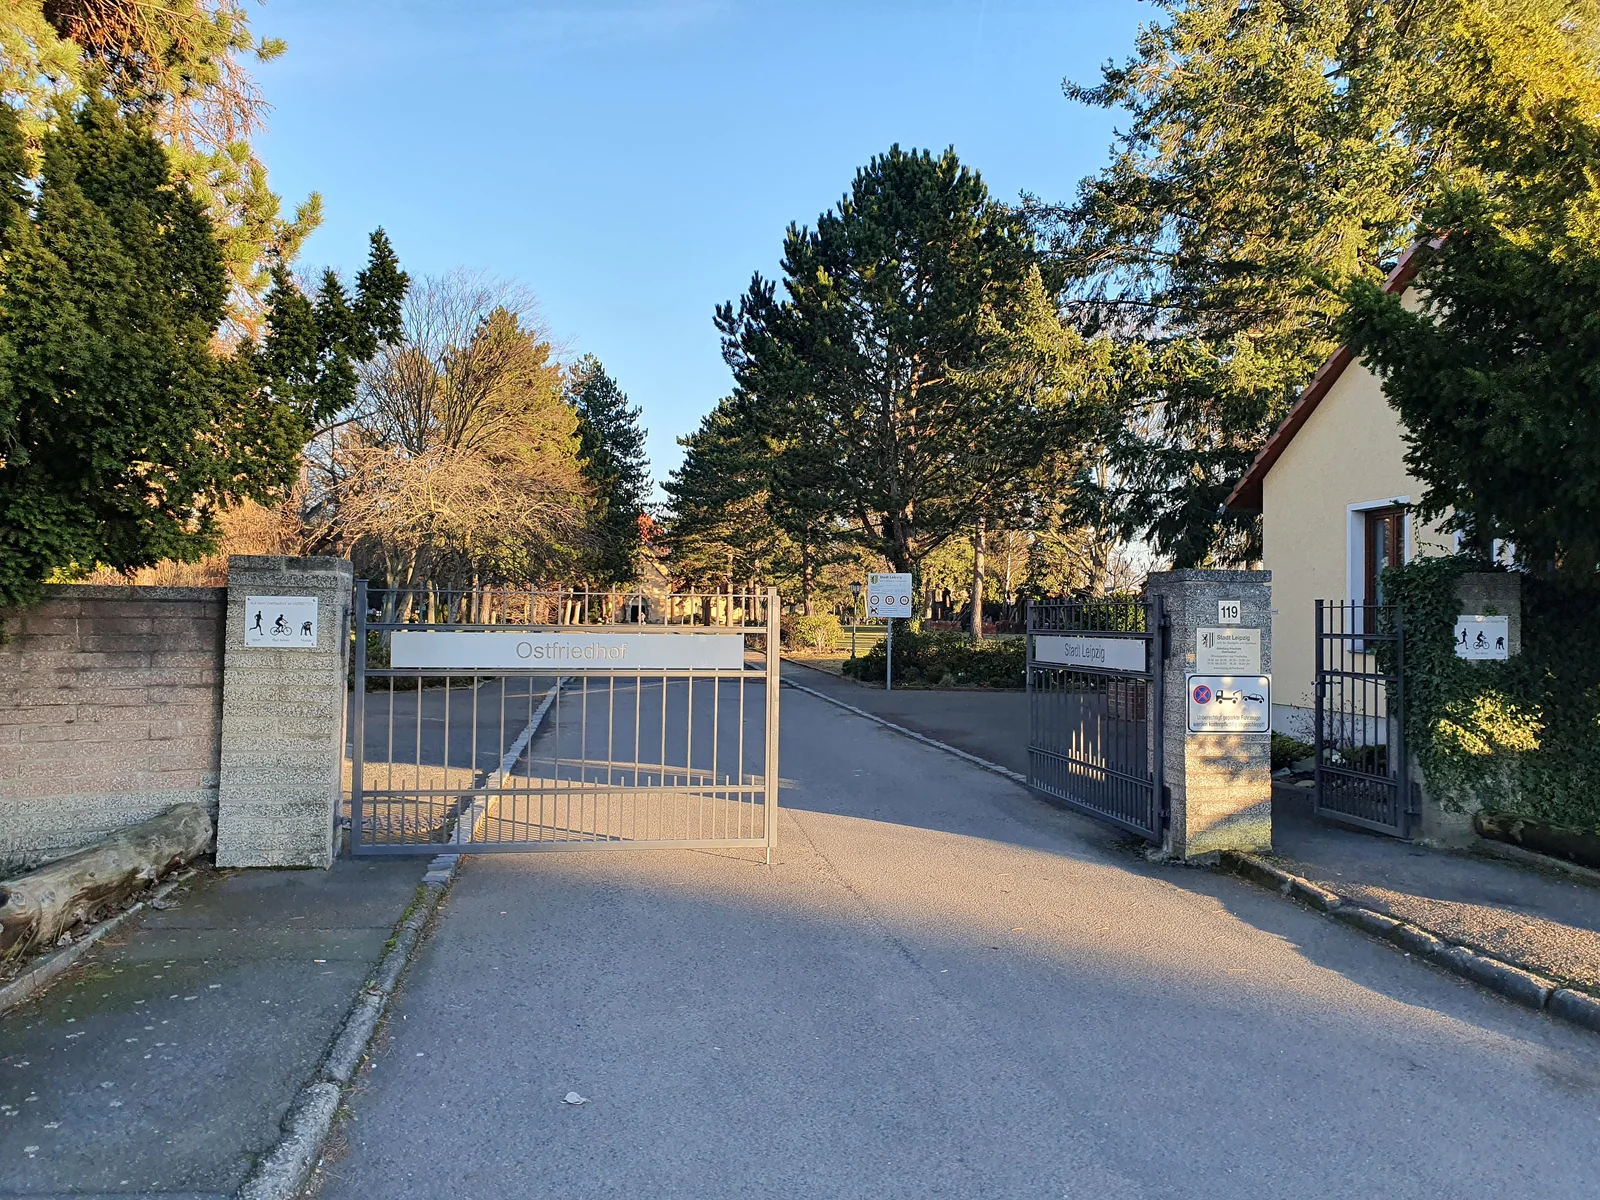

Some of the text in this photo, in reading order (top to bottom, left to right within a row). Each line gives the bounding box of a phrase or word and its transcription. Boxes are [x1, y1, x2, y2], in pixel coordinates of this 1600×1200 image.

[1221, 606, 1238, 618] 119
[516, 641, 628, 659] Ostfriedhof
[1064, 642, 1106, 663] Stadt Leipzig
